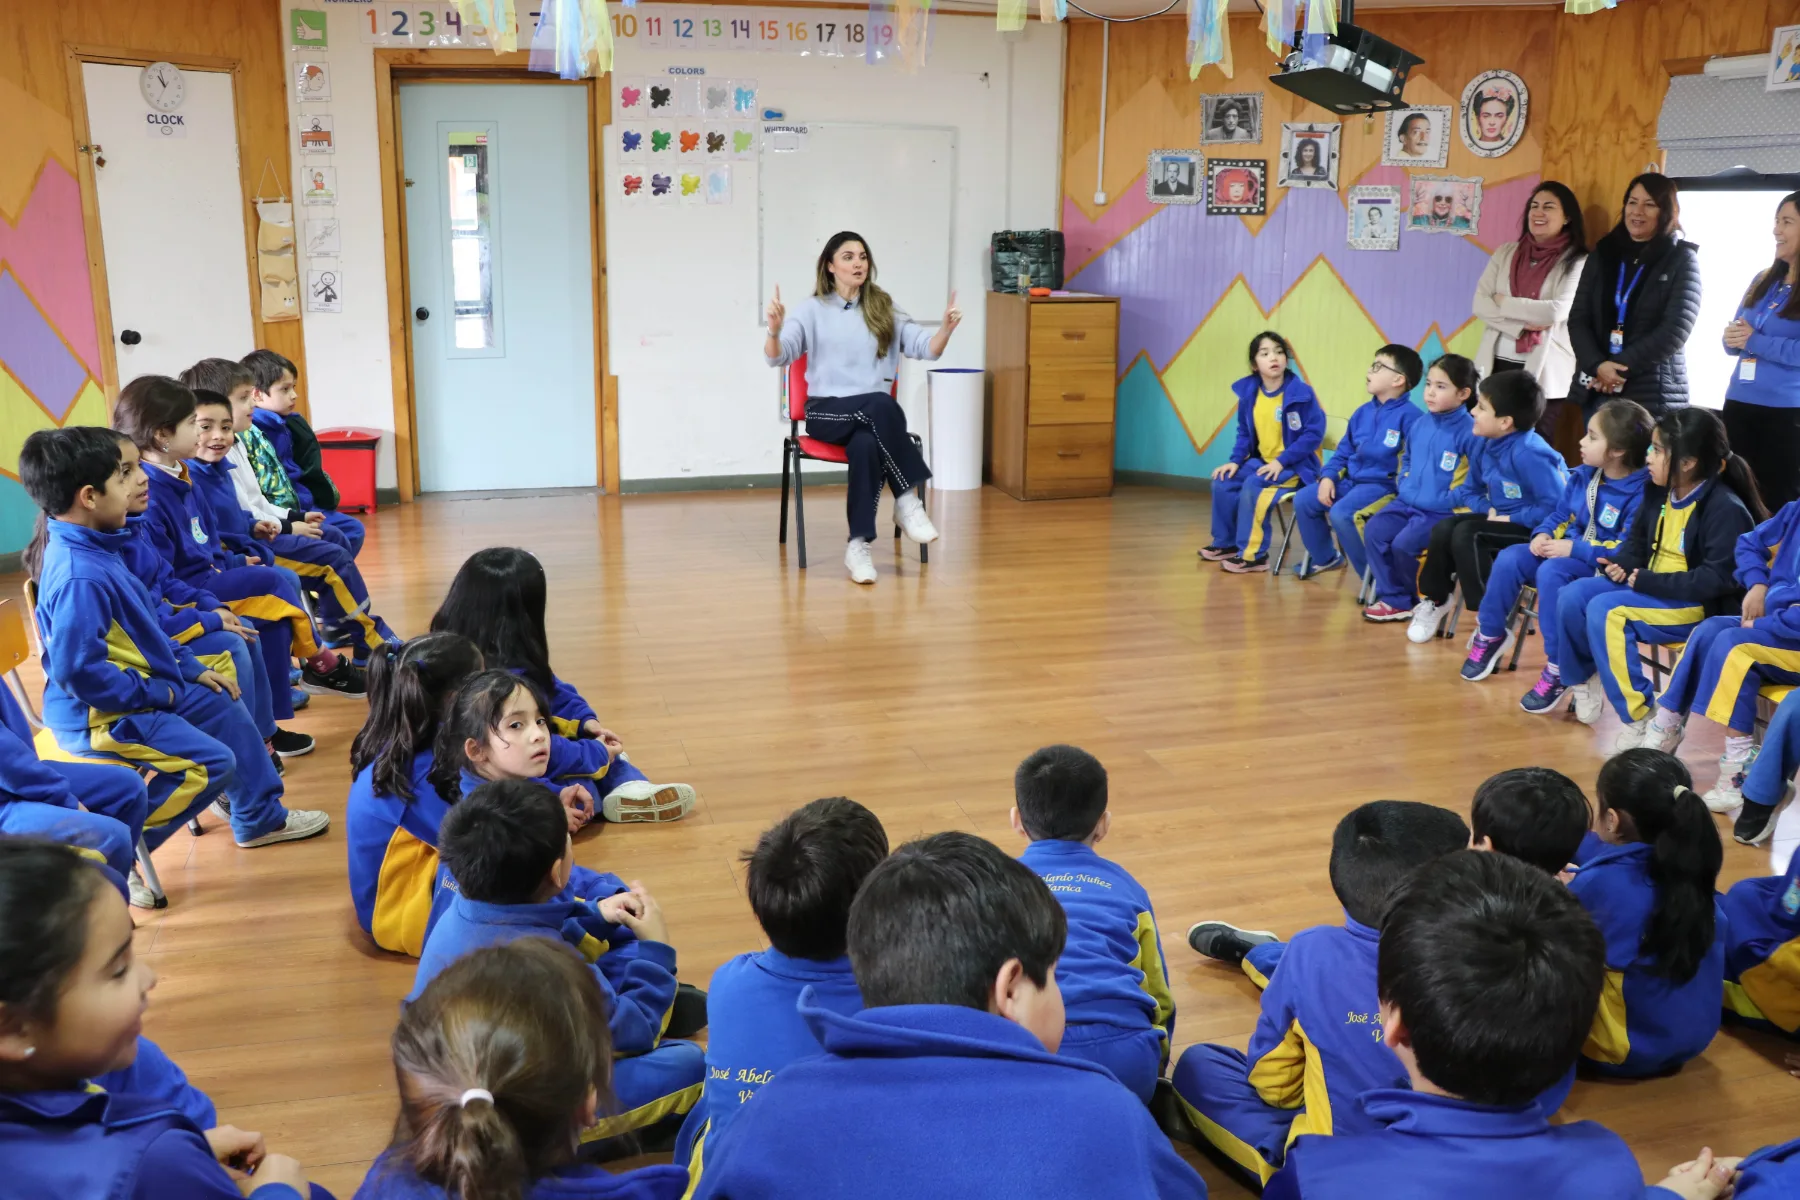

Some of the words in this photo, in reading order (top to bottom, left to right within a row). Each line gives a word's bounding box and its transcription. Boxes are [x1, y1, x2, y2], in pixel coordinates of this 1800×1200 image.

[366, 9, 377, 35] 1
[391, 10, 409, 36] 2
[419, 11, 436, 36] 3
[445, 11, 462, 36] 4
[612, 13, 638, 38] 10
[645, 17, 662, 37] 11
[672, 19, 694, 38] 12
[702, 19, 722, 37] 13
[730, 19, 750, 39] 14
[758, 20, 779, 40] 15
[786, 22, 808, 41] 16
[816, 23, 837, 43] 17
[844, 23, 865, 43] 18
[872, 25, 893, 46] 19
[668, 67, 705, 75] COLORS
[147, 114, 185, 126] CLOCK
[764, 125, 809, 134] WHITEBOARD
[1345, 1011, 1368, 1024] José
[709, 1066, 731, 1080] José
